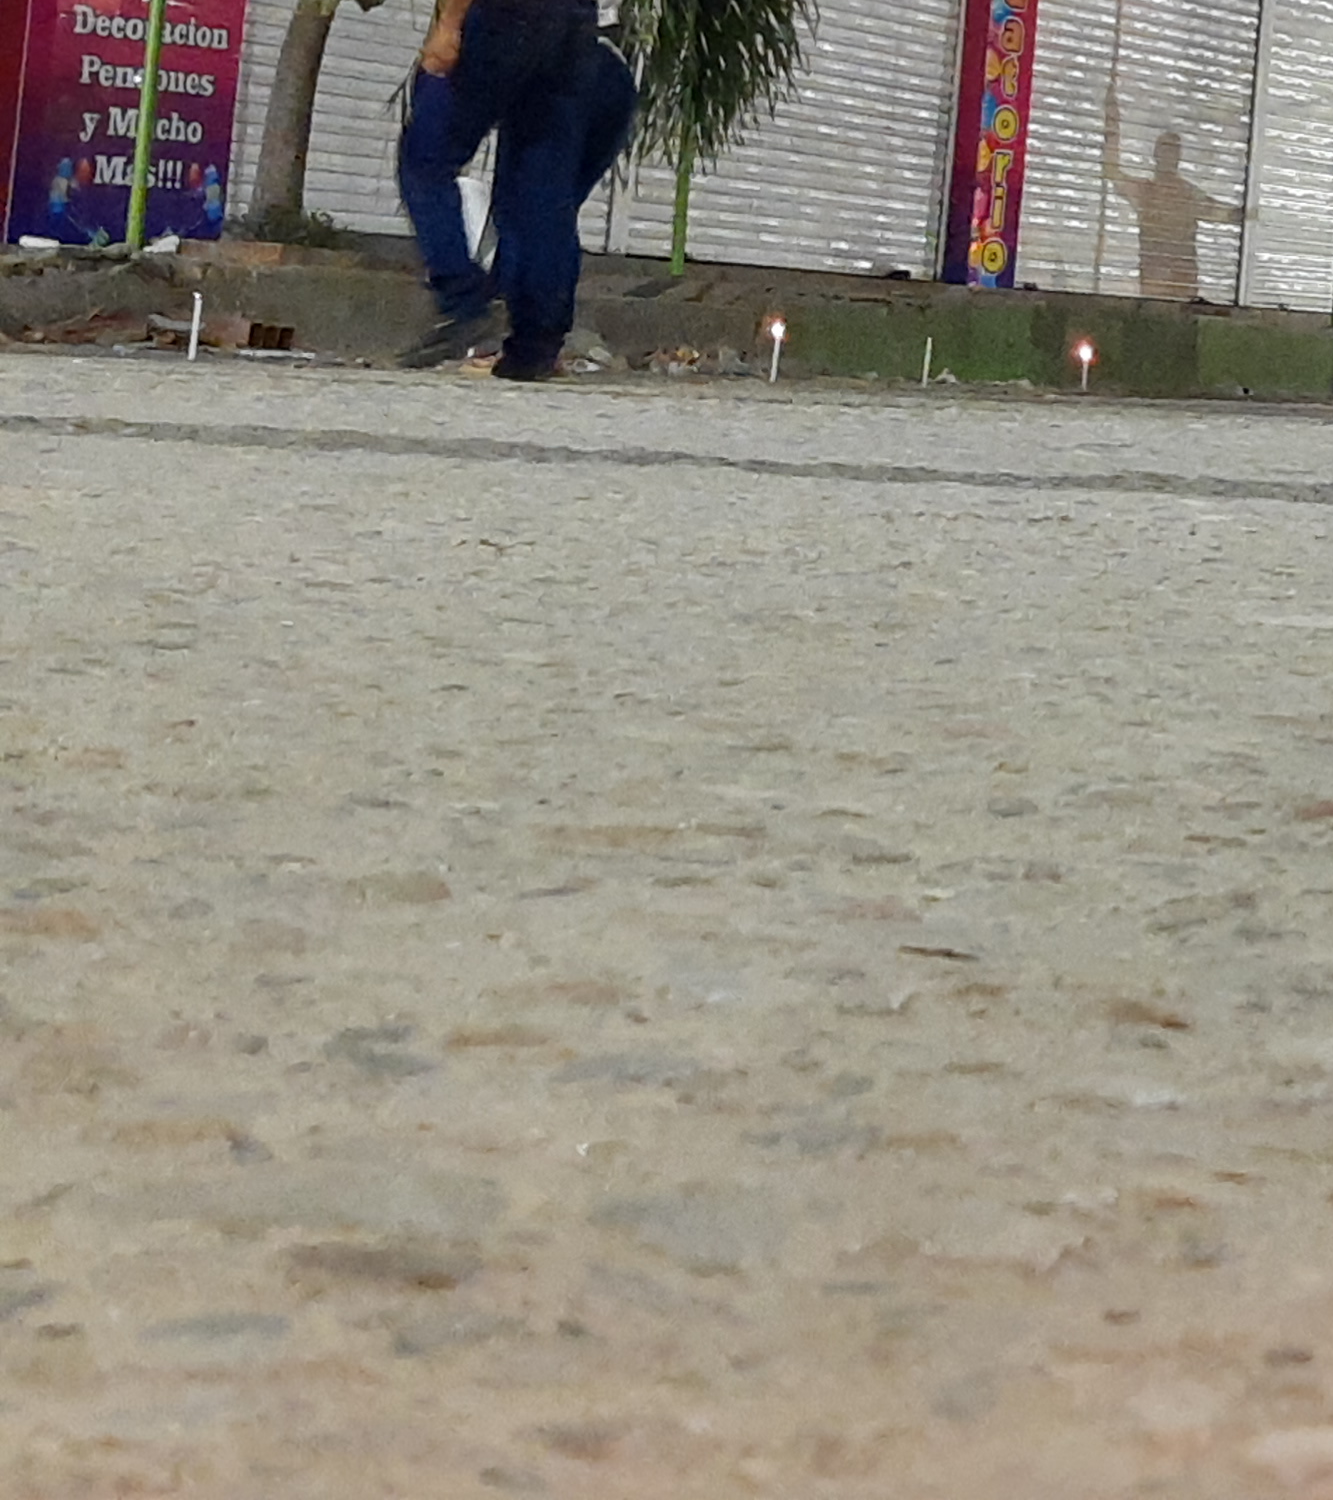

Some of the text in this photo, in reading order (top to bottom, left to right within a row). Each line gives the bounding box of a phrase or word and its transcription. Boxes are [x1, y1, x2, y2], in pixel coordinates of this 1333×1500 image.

[73, 4, 229, 49] Decoacion
[79, 106, 203, 143] y Mcho
